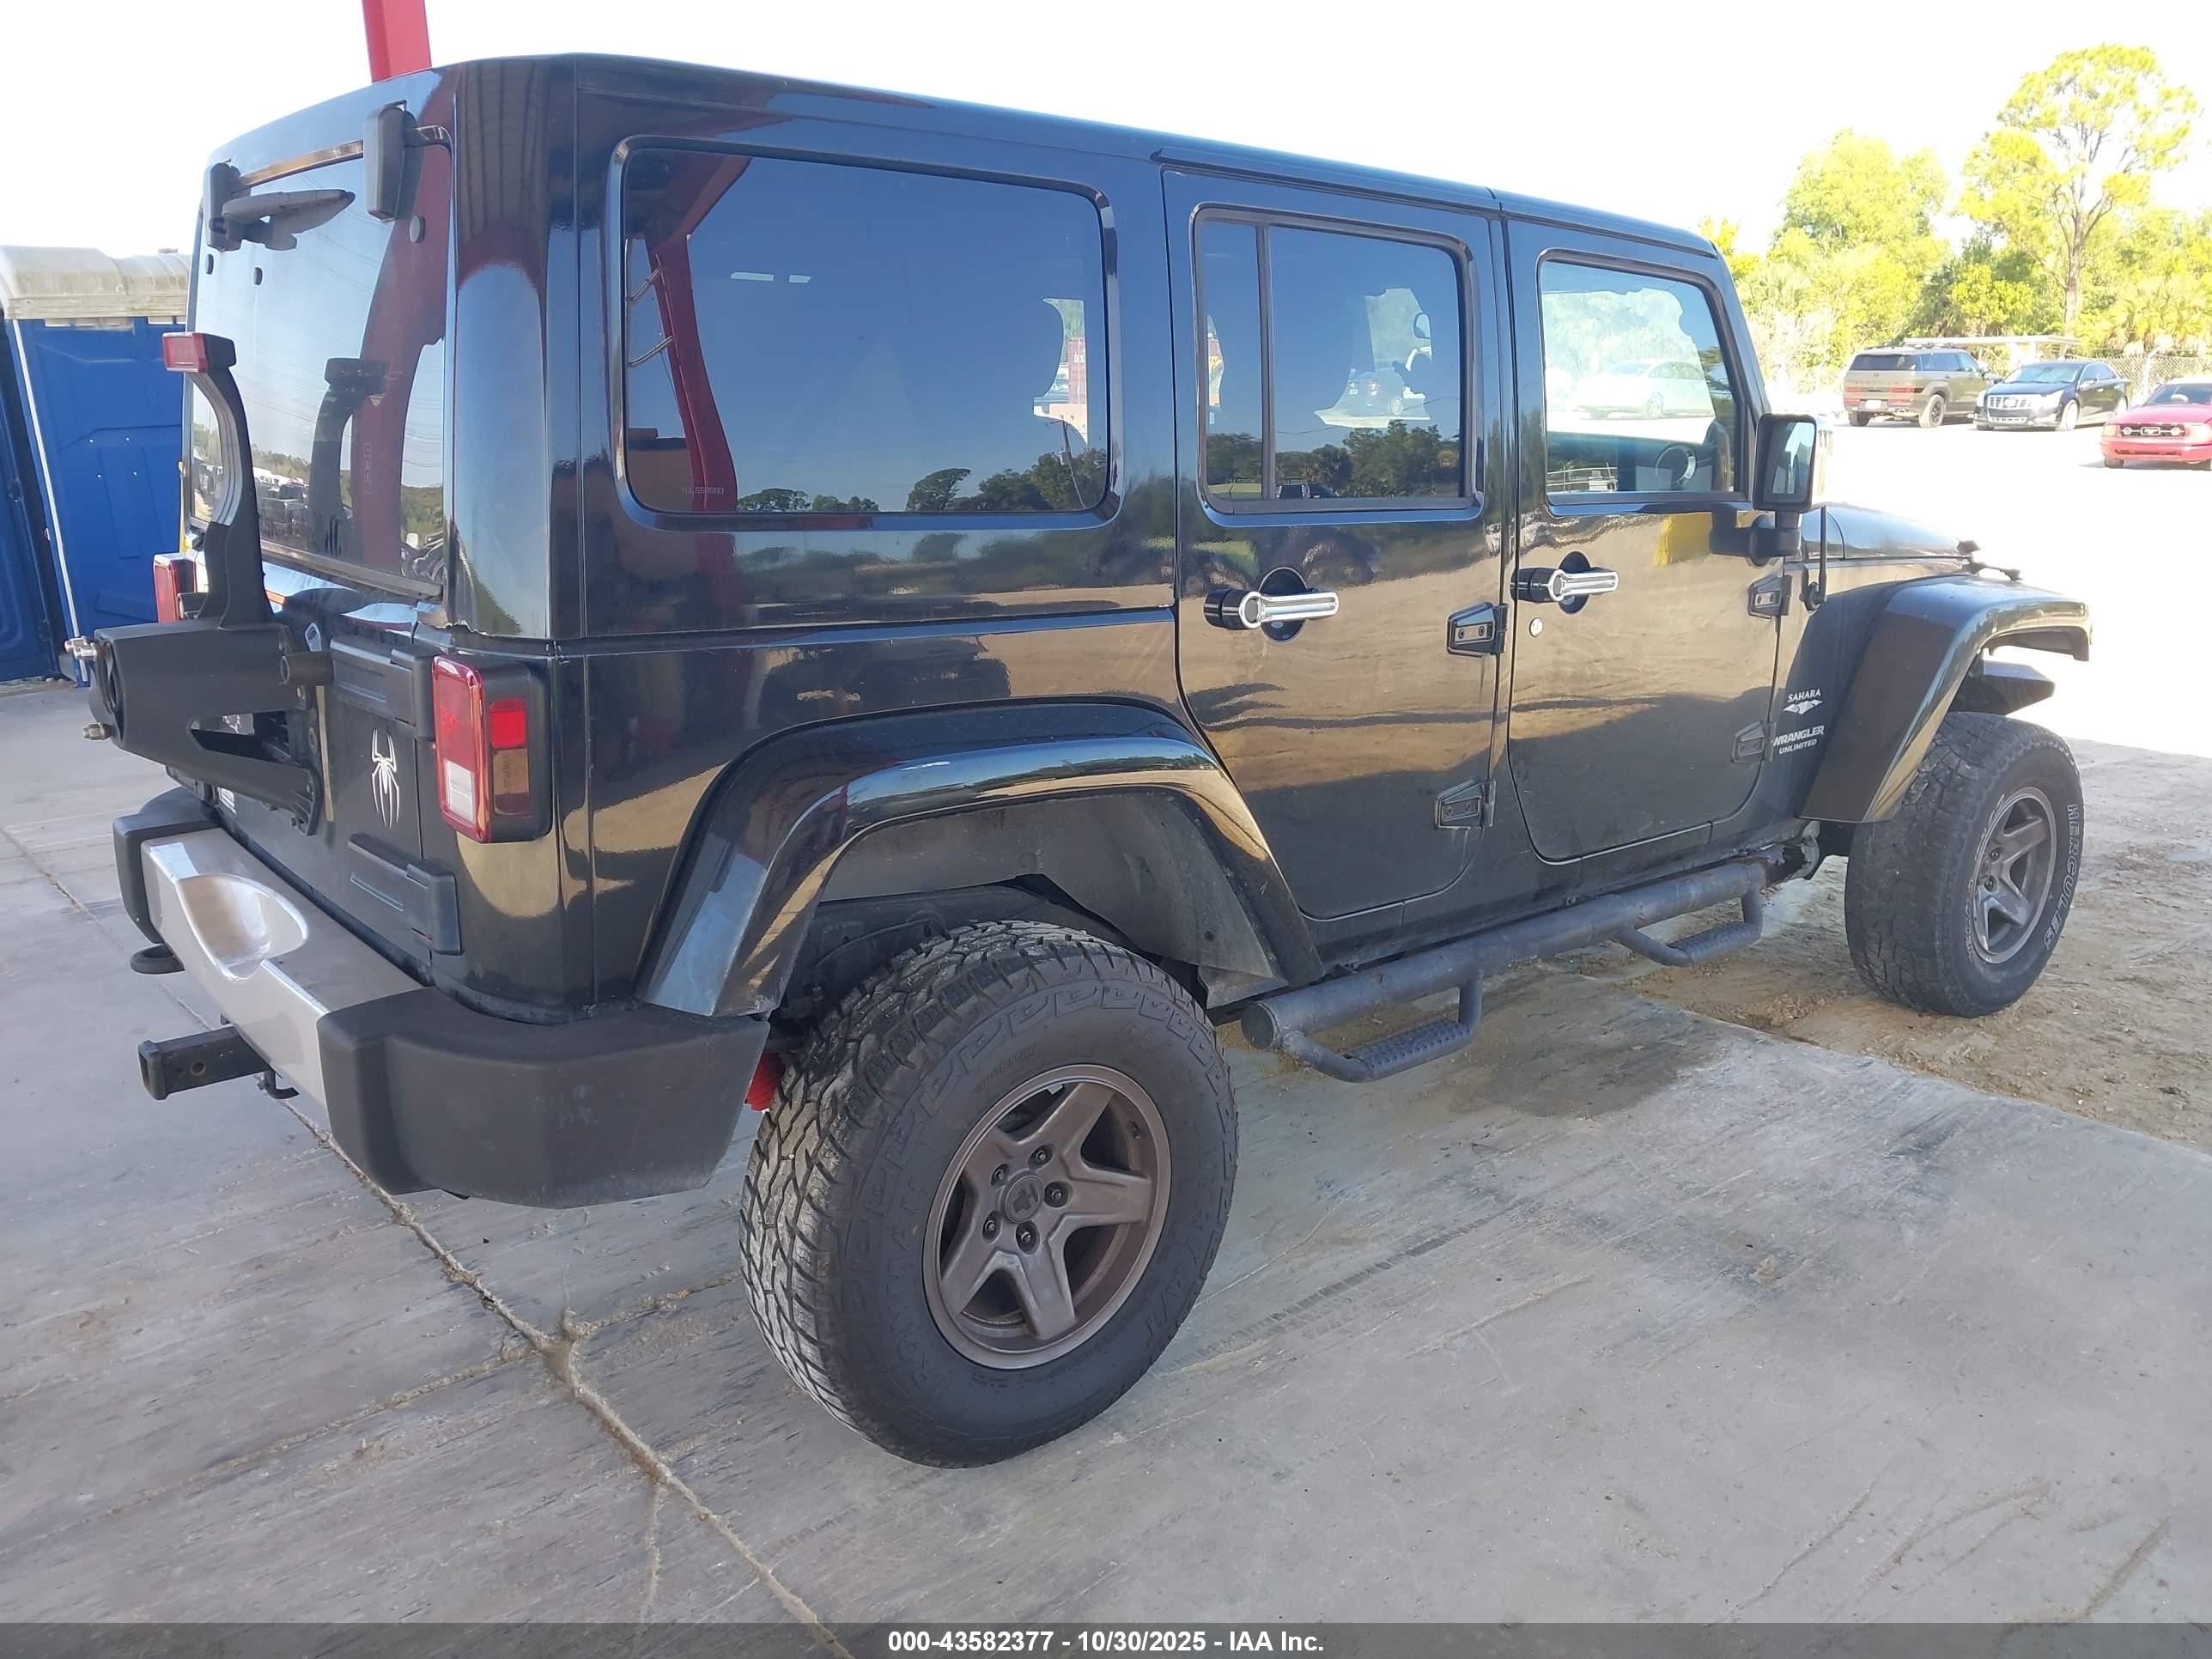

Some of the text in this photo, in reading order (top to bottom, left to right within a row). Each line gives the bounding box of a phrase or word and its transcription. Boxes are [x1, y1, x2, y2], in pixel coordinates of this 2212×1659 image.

[1787, 688, 1821, 702] SAHARA
[1773, 725, 1825, 746] WRANGLER
[1779, 738, 1818, 755] UNLIMITED
[2043, 804, 2080, 951] HERCULES
